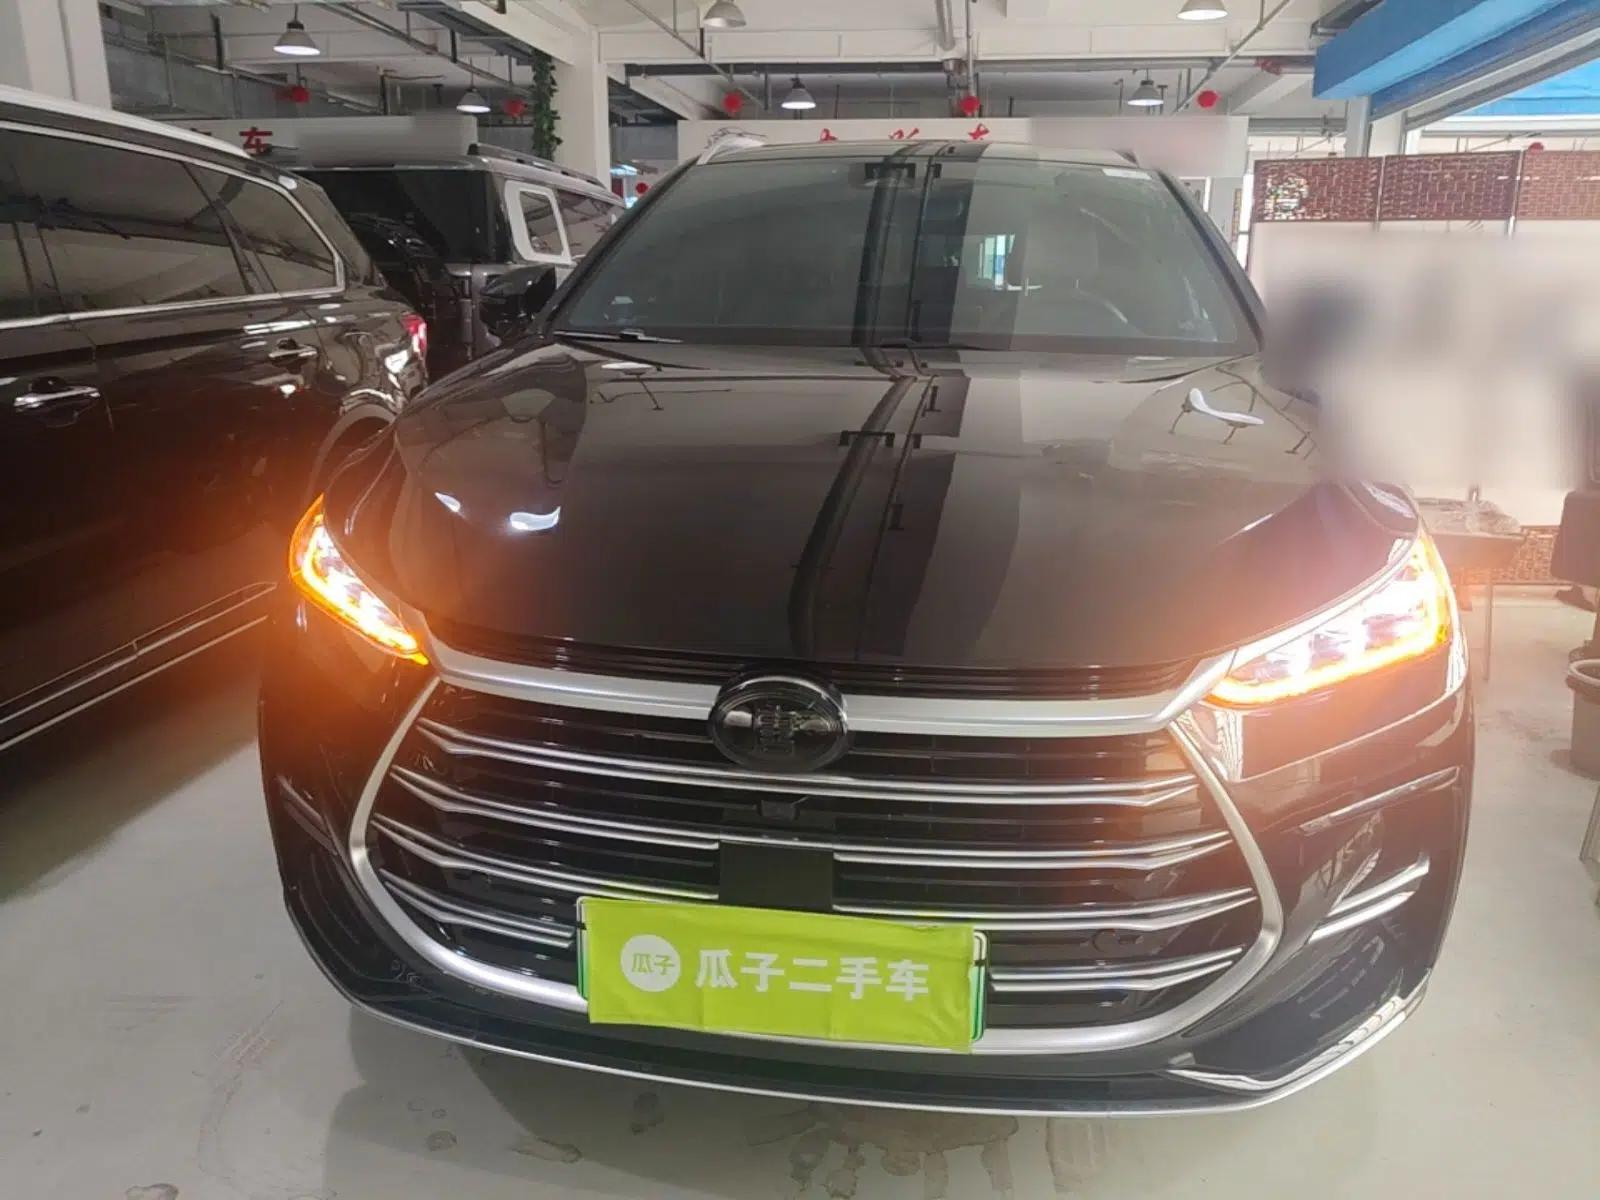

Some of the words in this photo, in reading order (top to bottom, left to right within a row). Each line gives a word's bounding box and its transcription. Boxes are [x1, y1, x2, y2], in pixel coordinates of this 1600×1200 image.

[631, 953, 675, 975] 瓜子
[695, 949, 929, 1000] 瓜子二手车
